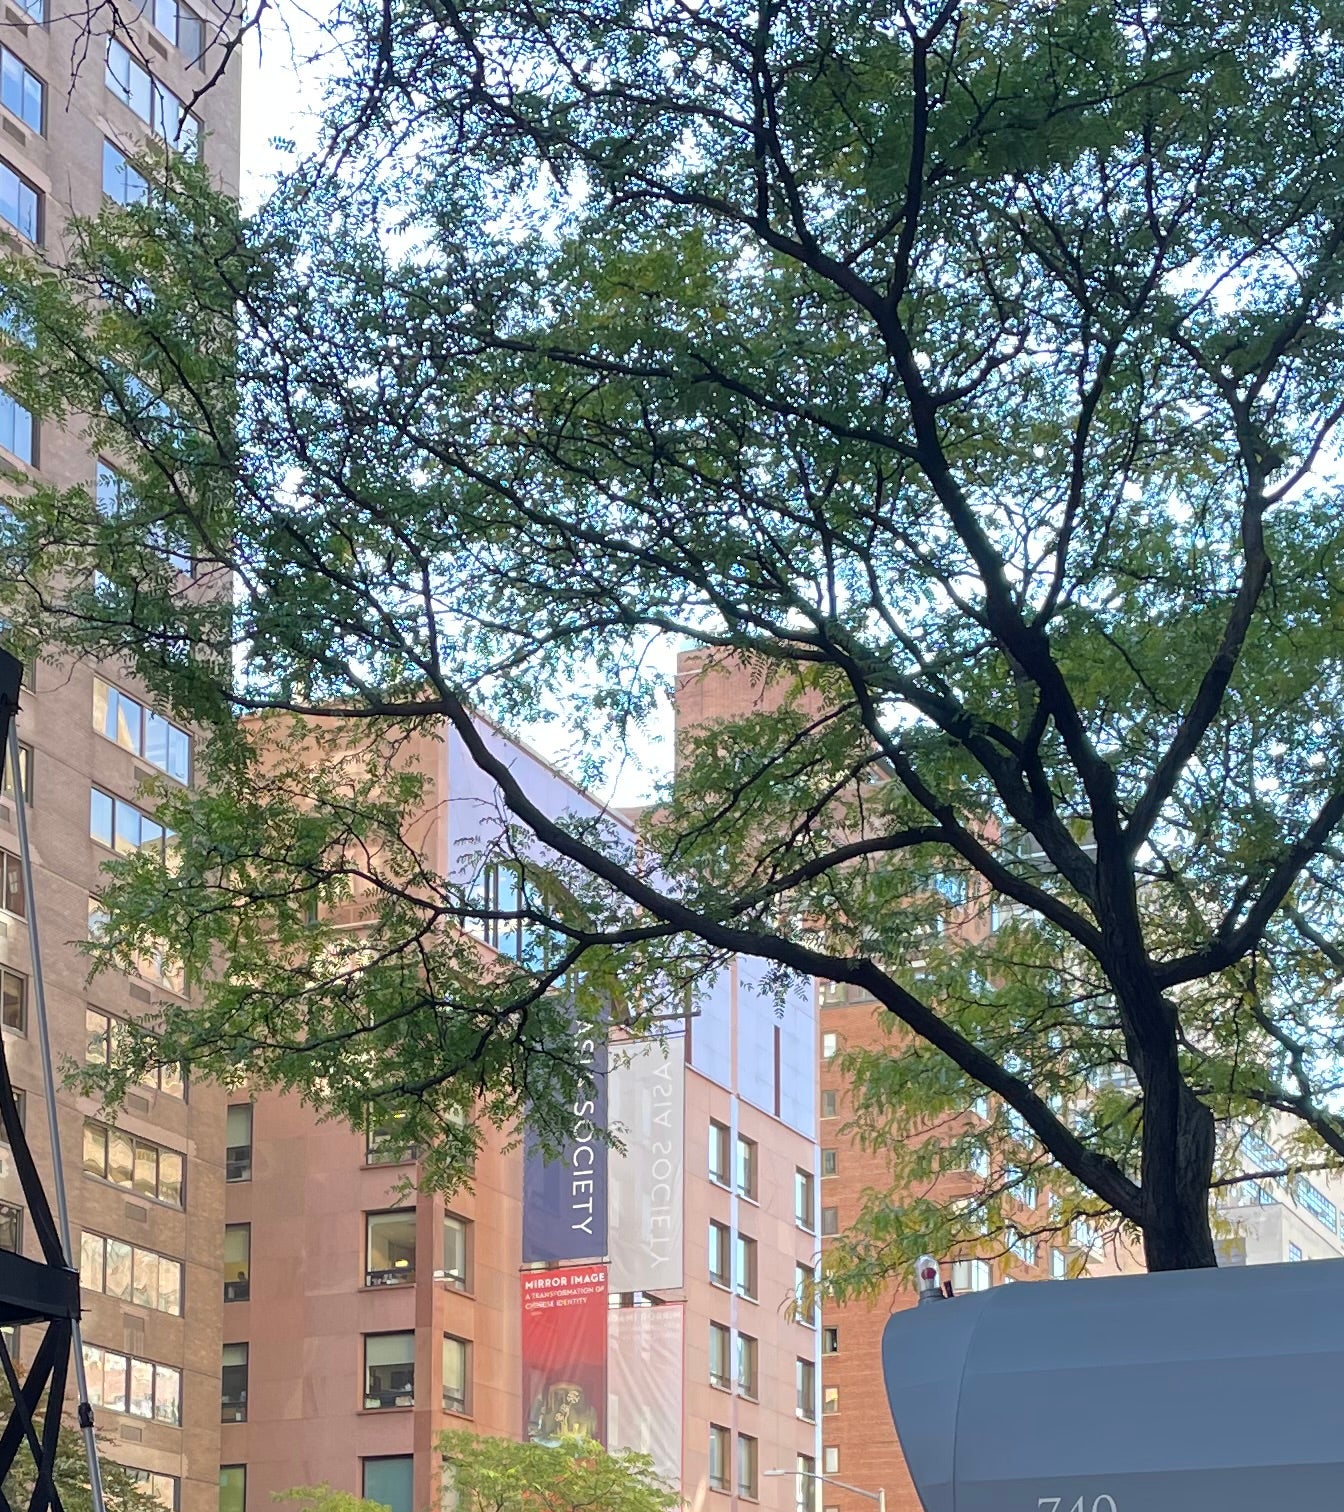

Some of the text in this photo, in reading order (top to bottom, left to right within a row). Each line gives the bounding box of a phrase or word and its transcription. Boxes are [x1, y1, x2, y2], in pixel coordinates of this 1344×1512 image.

[571, 1100, 595, 1235] SOCIETY
[524, 1272, 605, 1290] MIRROR IMAGE
[524, 1285, 605, 1301] A TRANSFORMATION OF
[556, 1297, 588, 1307] IDENTITY
